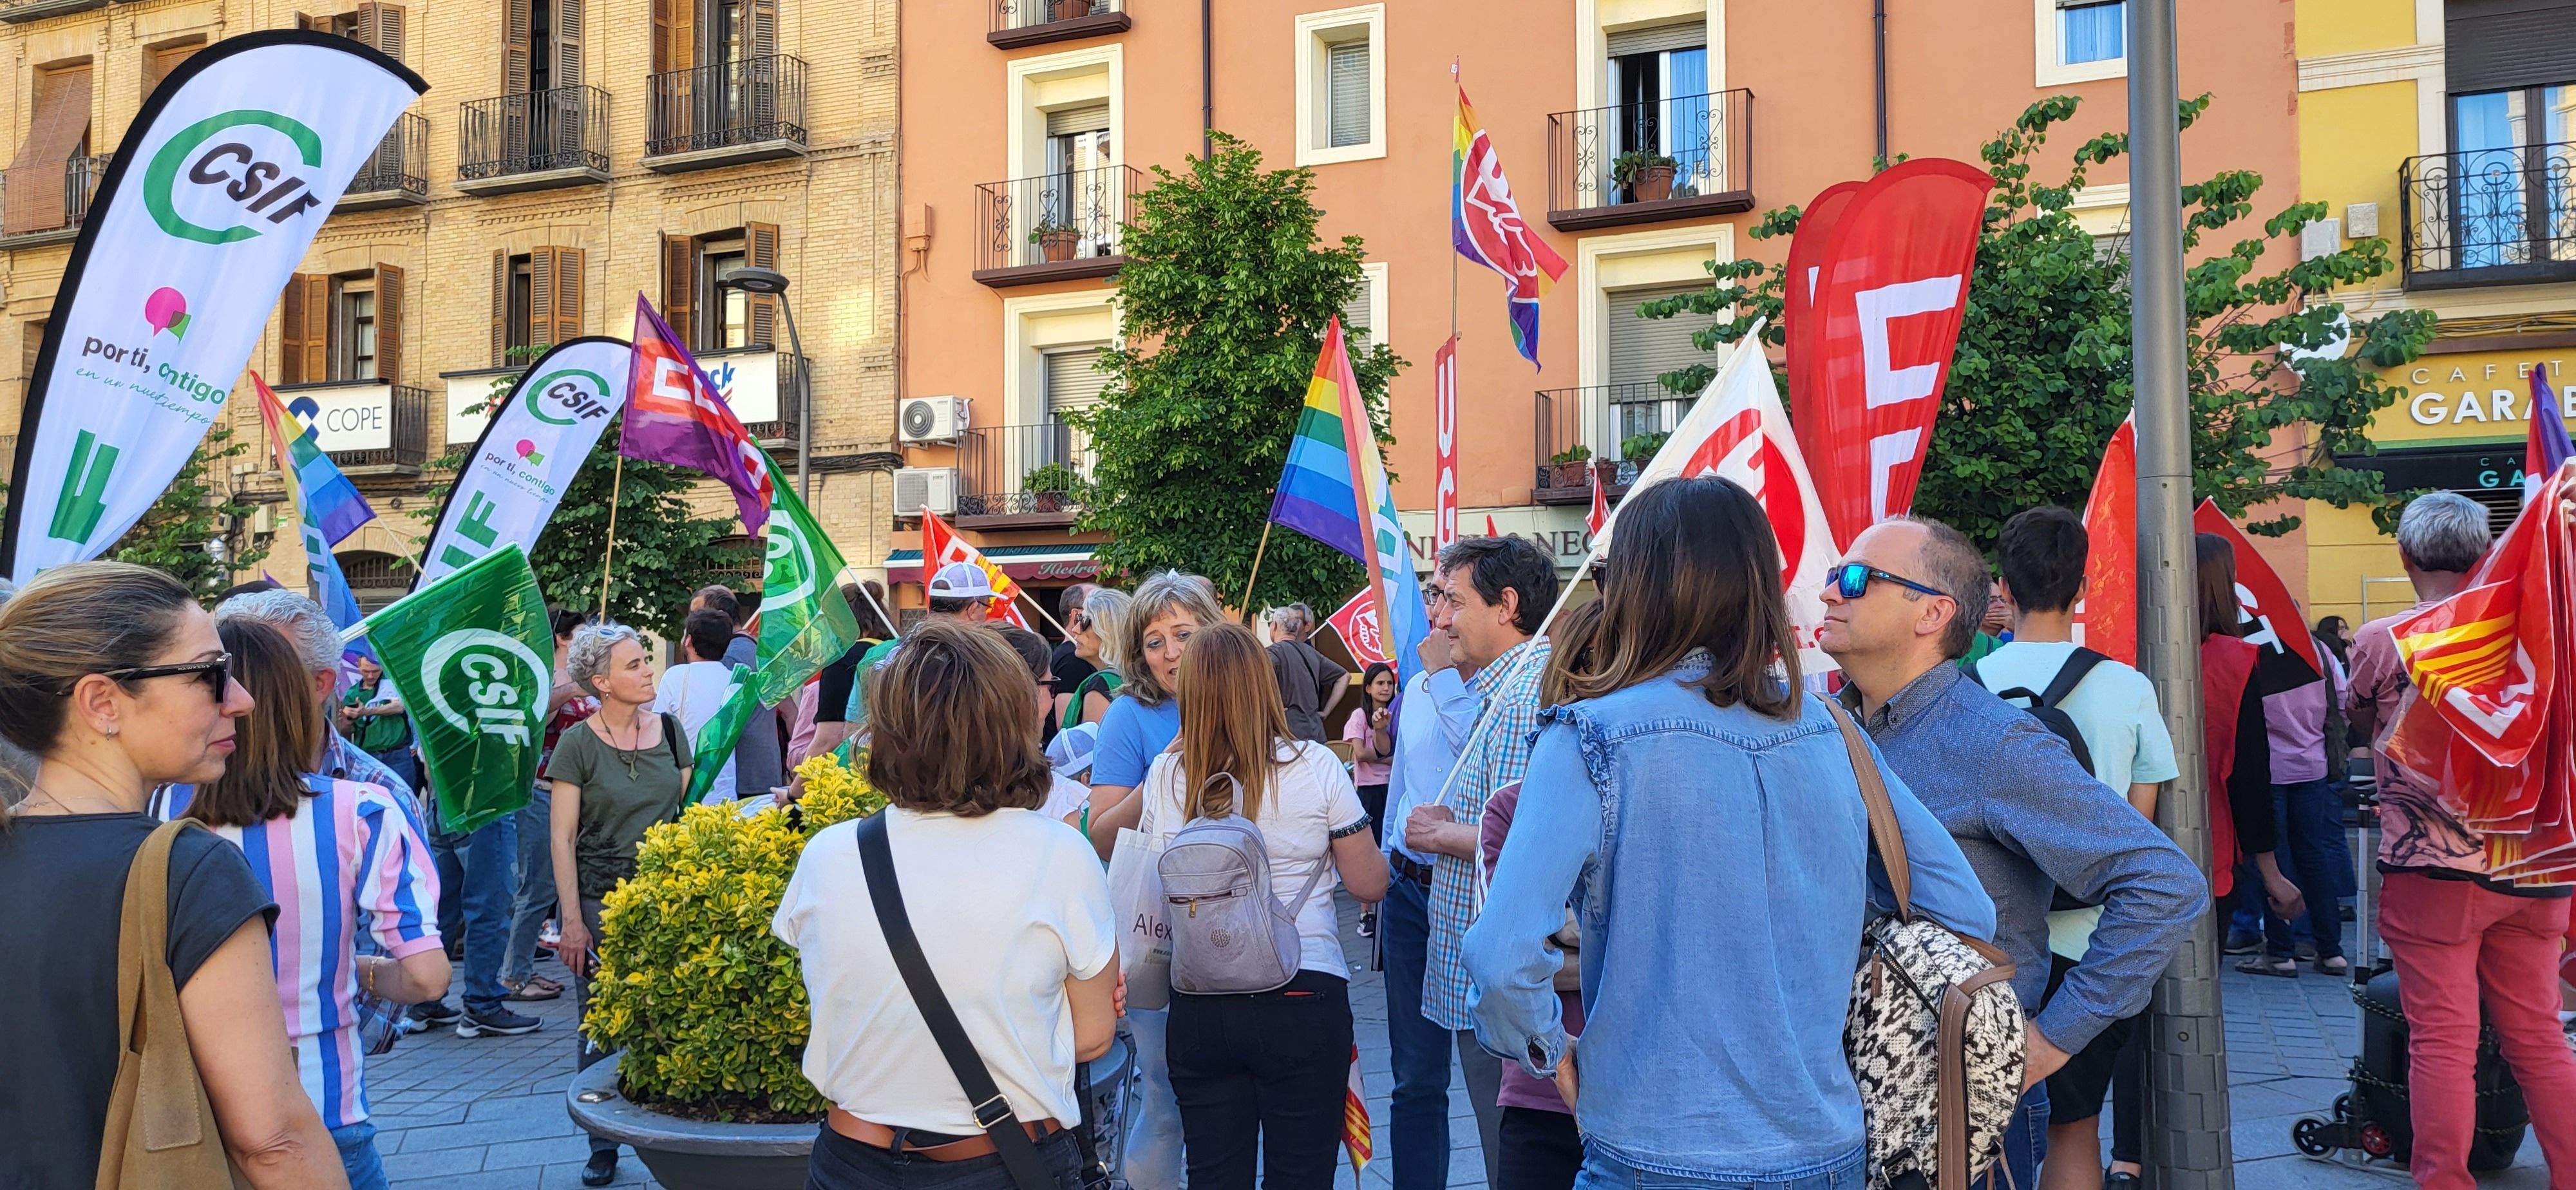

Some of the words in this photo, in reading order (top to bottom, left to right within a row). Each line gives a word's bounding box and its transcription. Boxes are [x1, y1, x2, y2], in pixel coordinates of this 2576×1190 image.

[82, 336, 129, 363] por
[158, 362, 225, 404] cntigo
[327, 406, 383, 432] COPE
[547, 382, 610, 419] CSIF
[2411, 386, 2576, 425] GAR
[485, 452, 506, 466] por
[518, 471, 555, 495] contigo
[461, 654, 531, 747] CSIF
